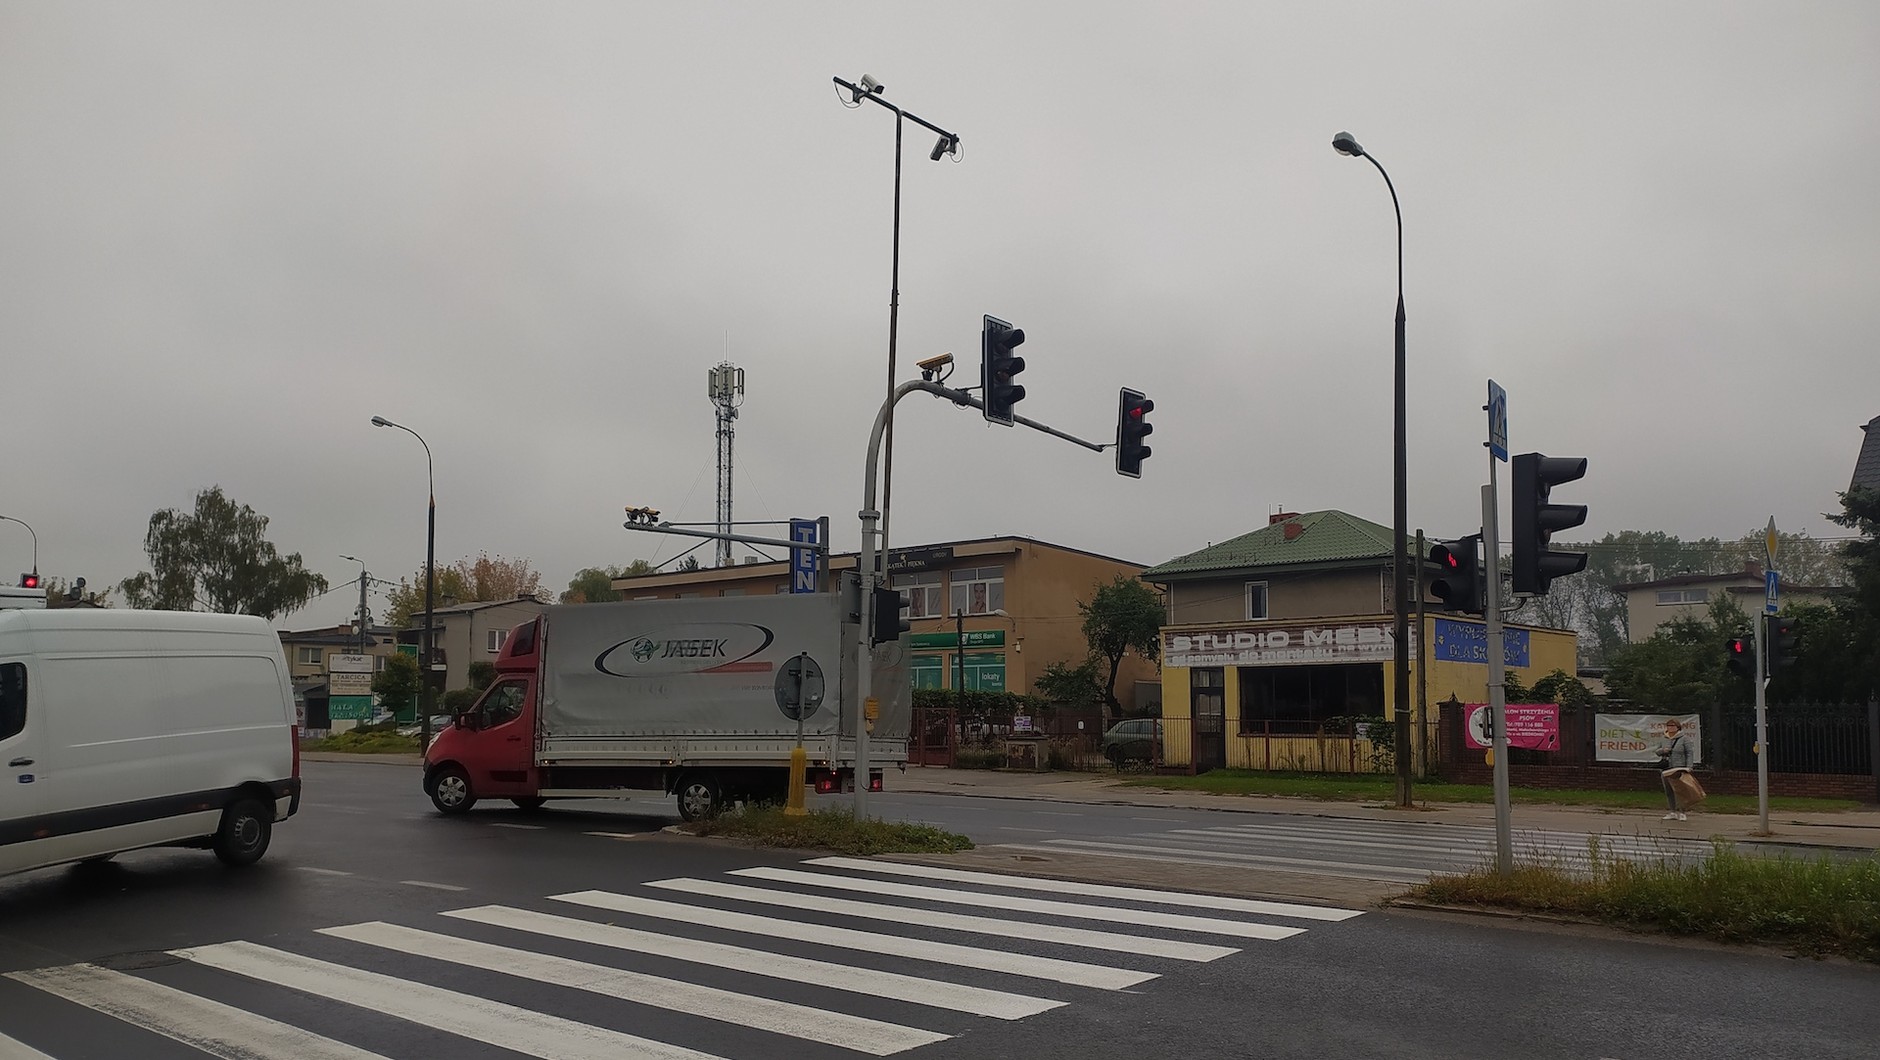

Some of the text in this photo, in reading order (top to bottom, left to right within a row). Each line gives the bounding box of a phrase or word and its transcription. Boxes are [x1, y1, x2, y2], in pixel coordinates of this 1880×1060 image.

[983, 632, 996, 640] Bank
[1172, 631, 1289, 652] STUDIO
[661, 638, 728, 659] JASEK
[981, 672, 1001, 682] lokaty
[1600, 729, 1627, 738] DIET
[1600, 741, 1647, 751] FRIEND
